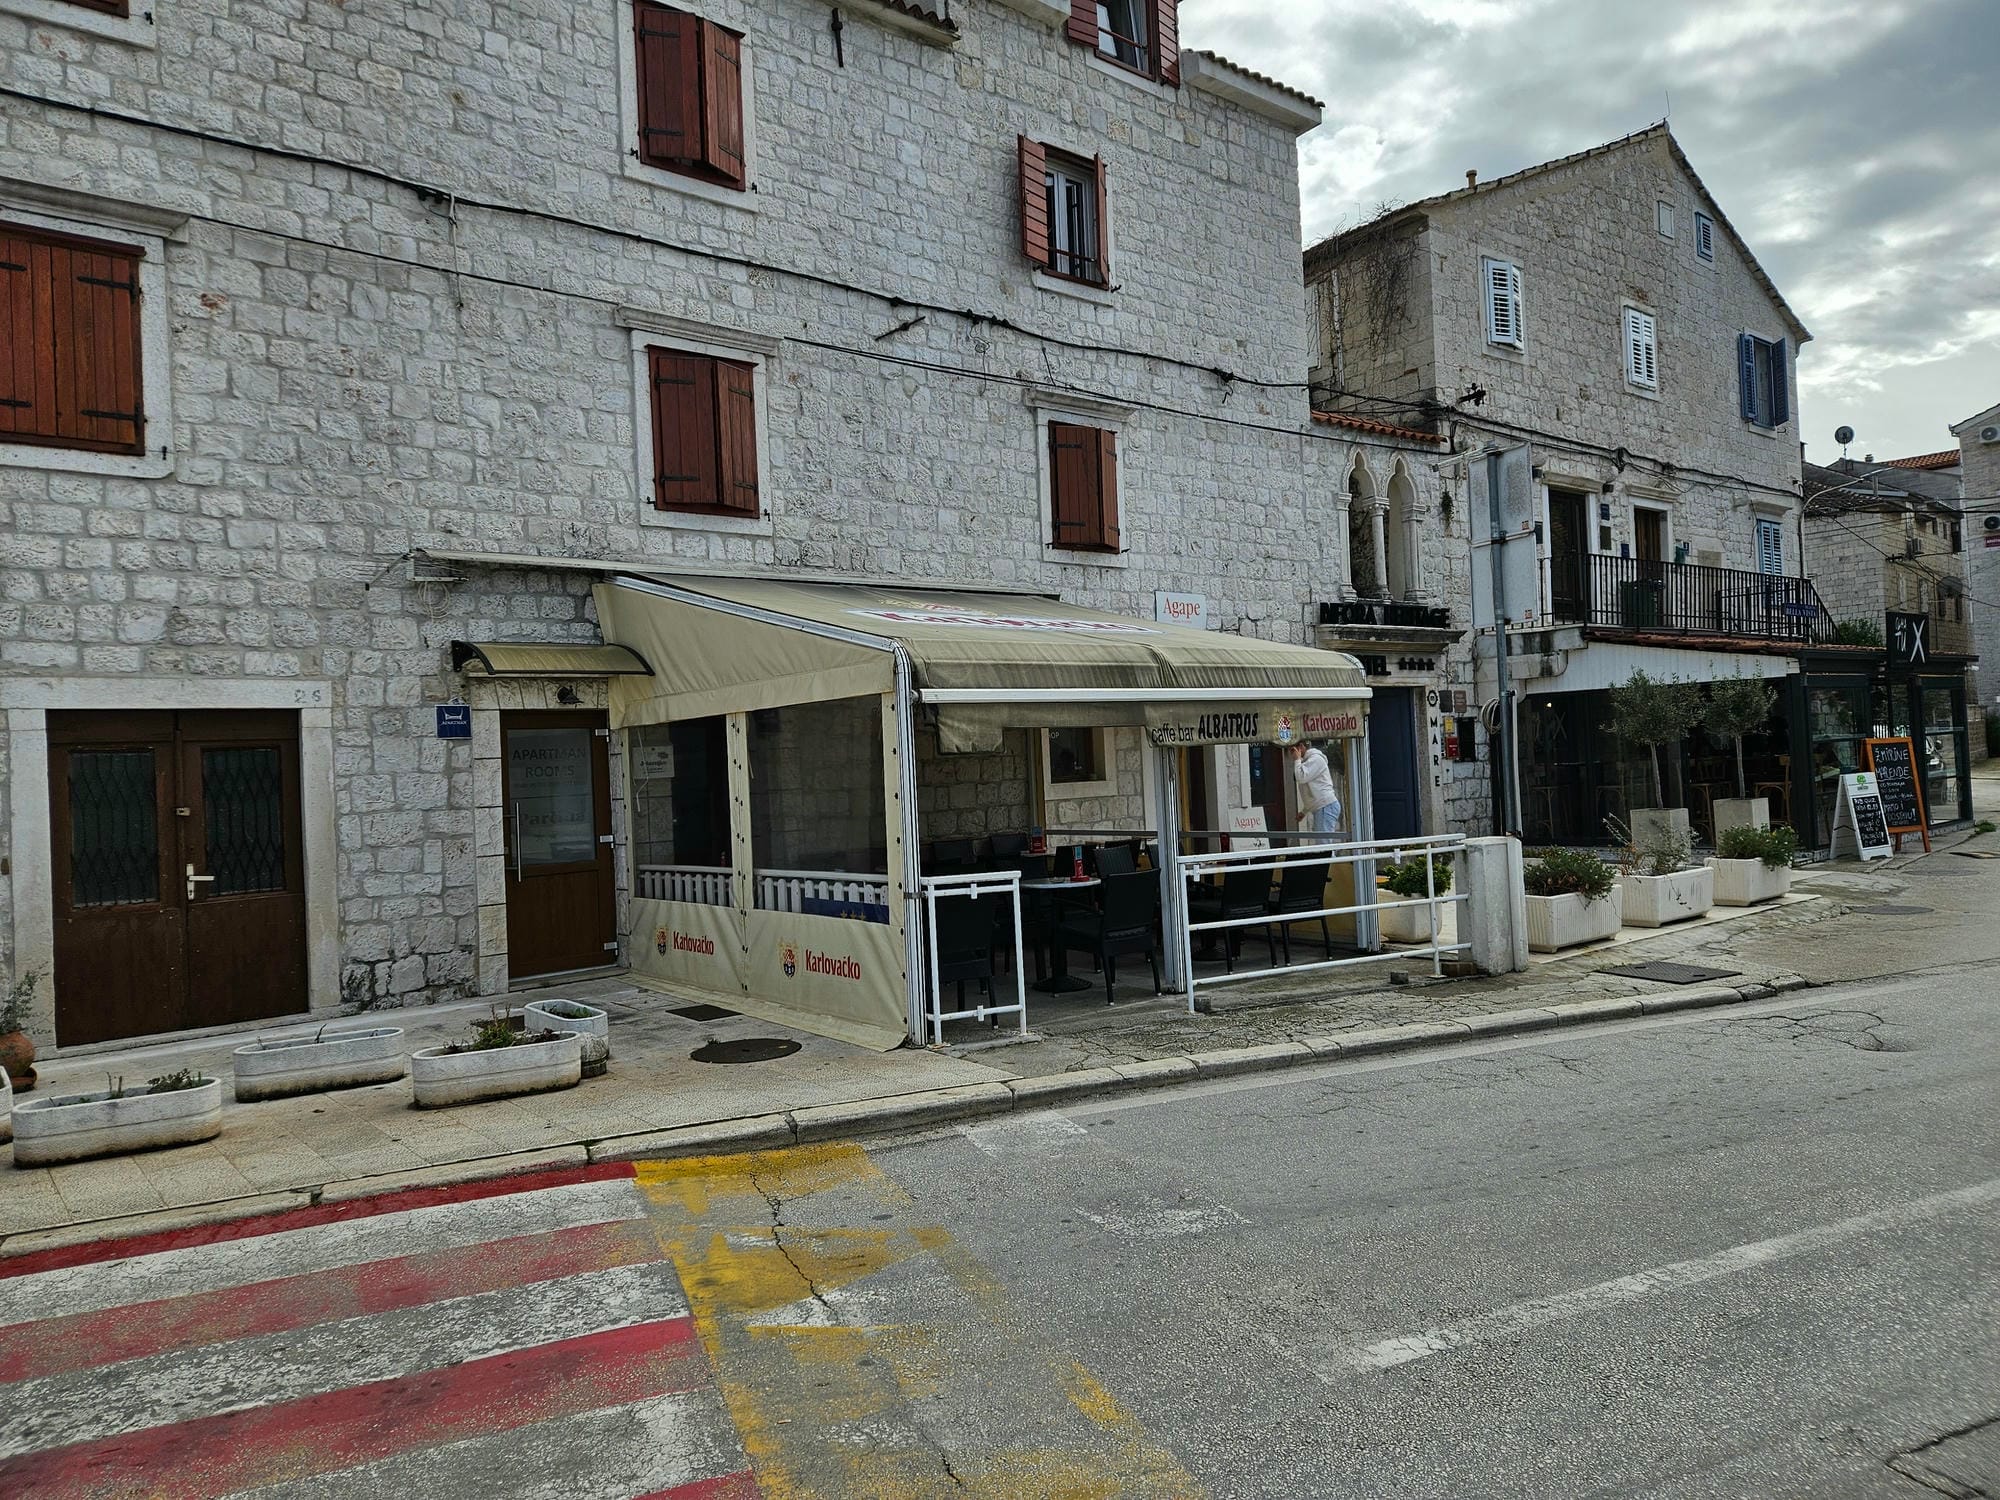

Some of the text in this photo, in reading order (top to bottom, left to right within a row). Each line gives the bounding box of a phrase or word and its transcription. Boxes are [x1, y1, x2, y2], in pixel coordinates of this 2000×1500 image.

[1163, 596, 1200, 619] Agape
[1152, 713, 1357, 743] caffe bar ALBATROS Karlovačko
[512, 748, 585, 761] APARTMAN
[673, 931, 714, 955] Karlovačko
[806, 949, 861, 980] Karlovačko
